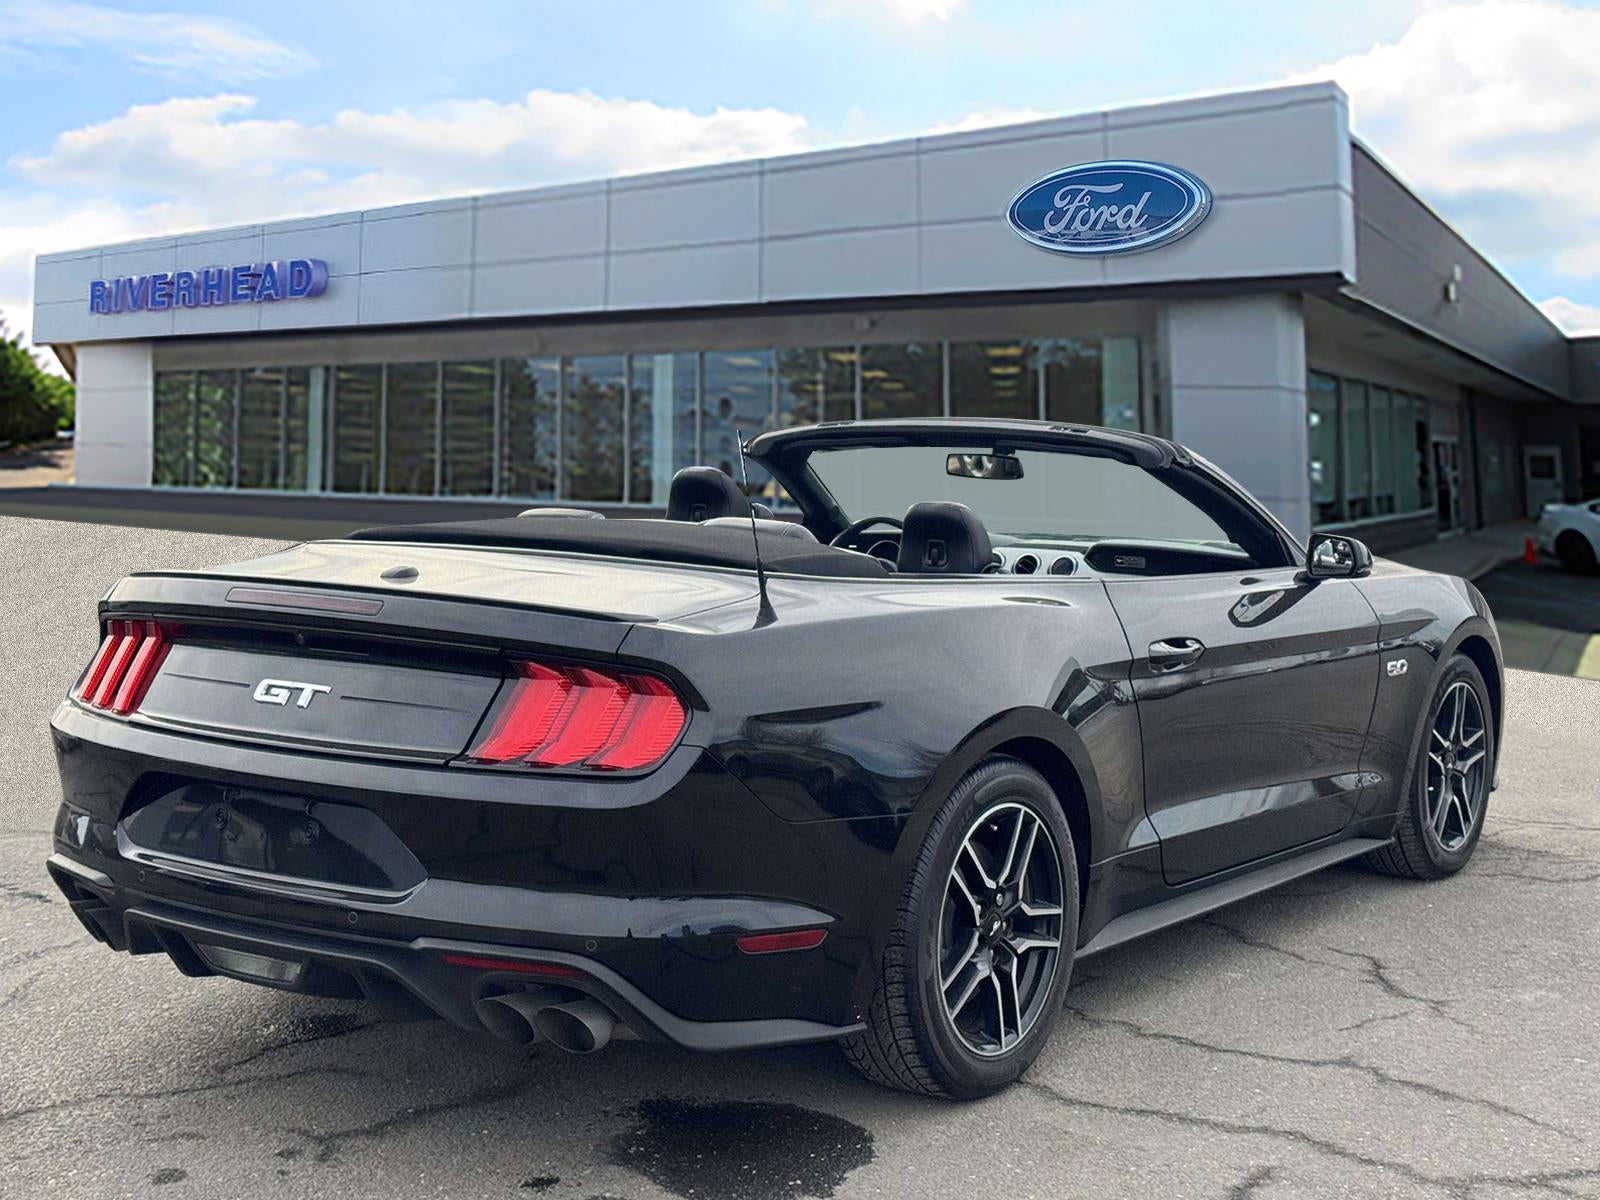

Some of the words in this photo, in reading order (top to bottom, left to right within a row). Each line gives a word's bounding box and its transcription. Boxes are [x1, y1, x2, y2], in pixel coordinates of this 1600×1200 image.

[1043, 183, 1151, 233] Ford
[90, 258, 326, 314] RIVERHEAD
[253, 678, 332, 709] GT
